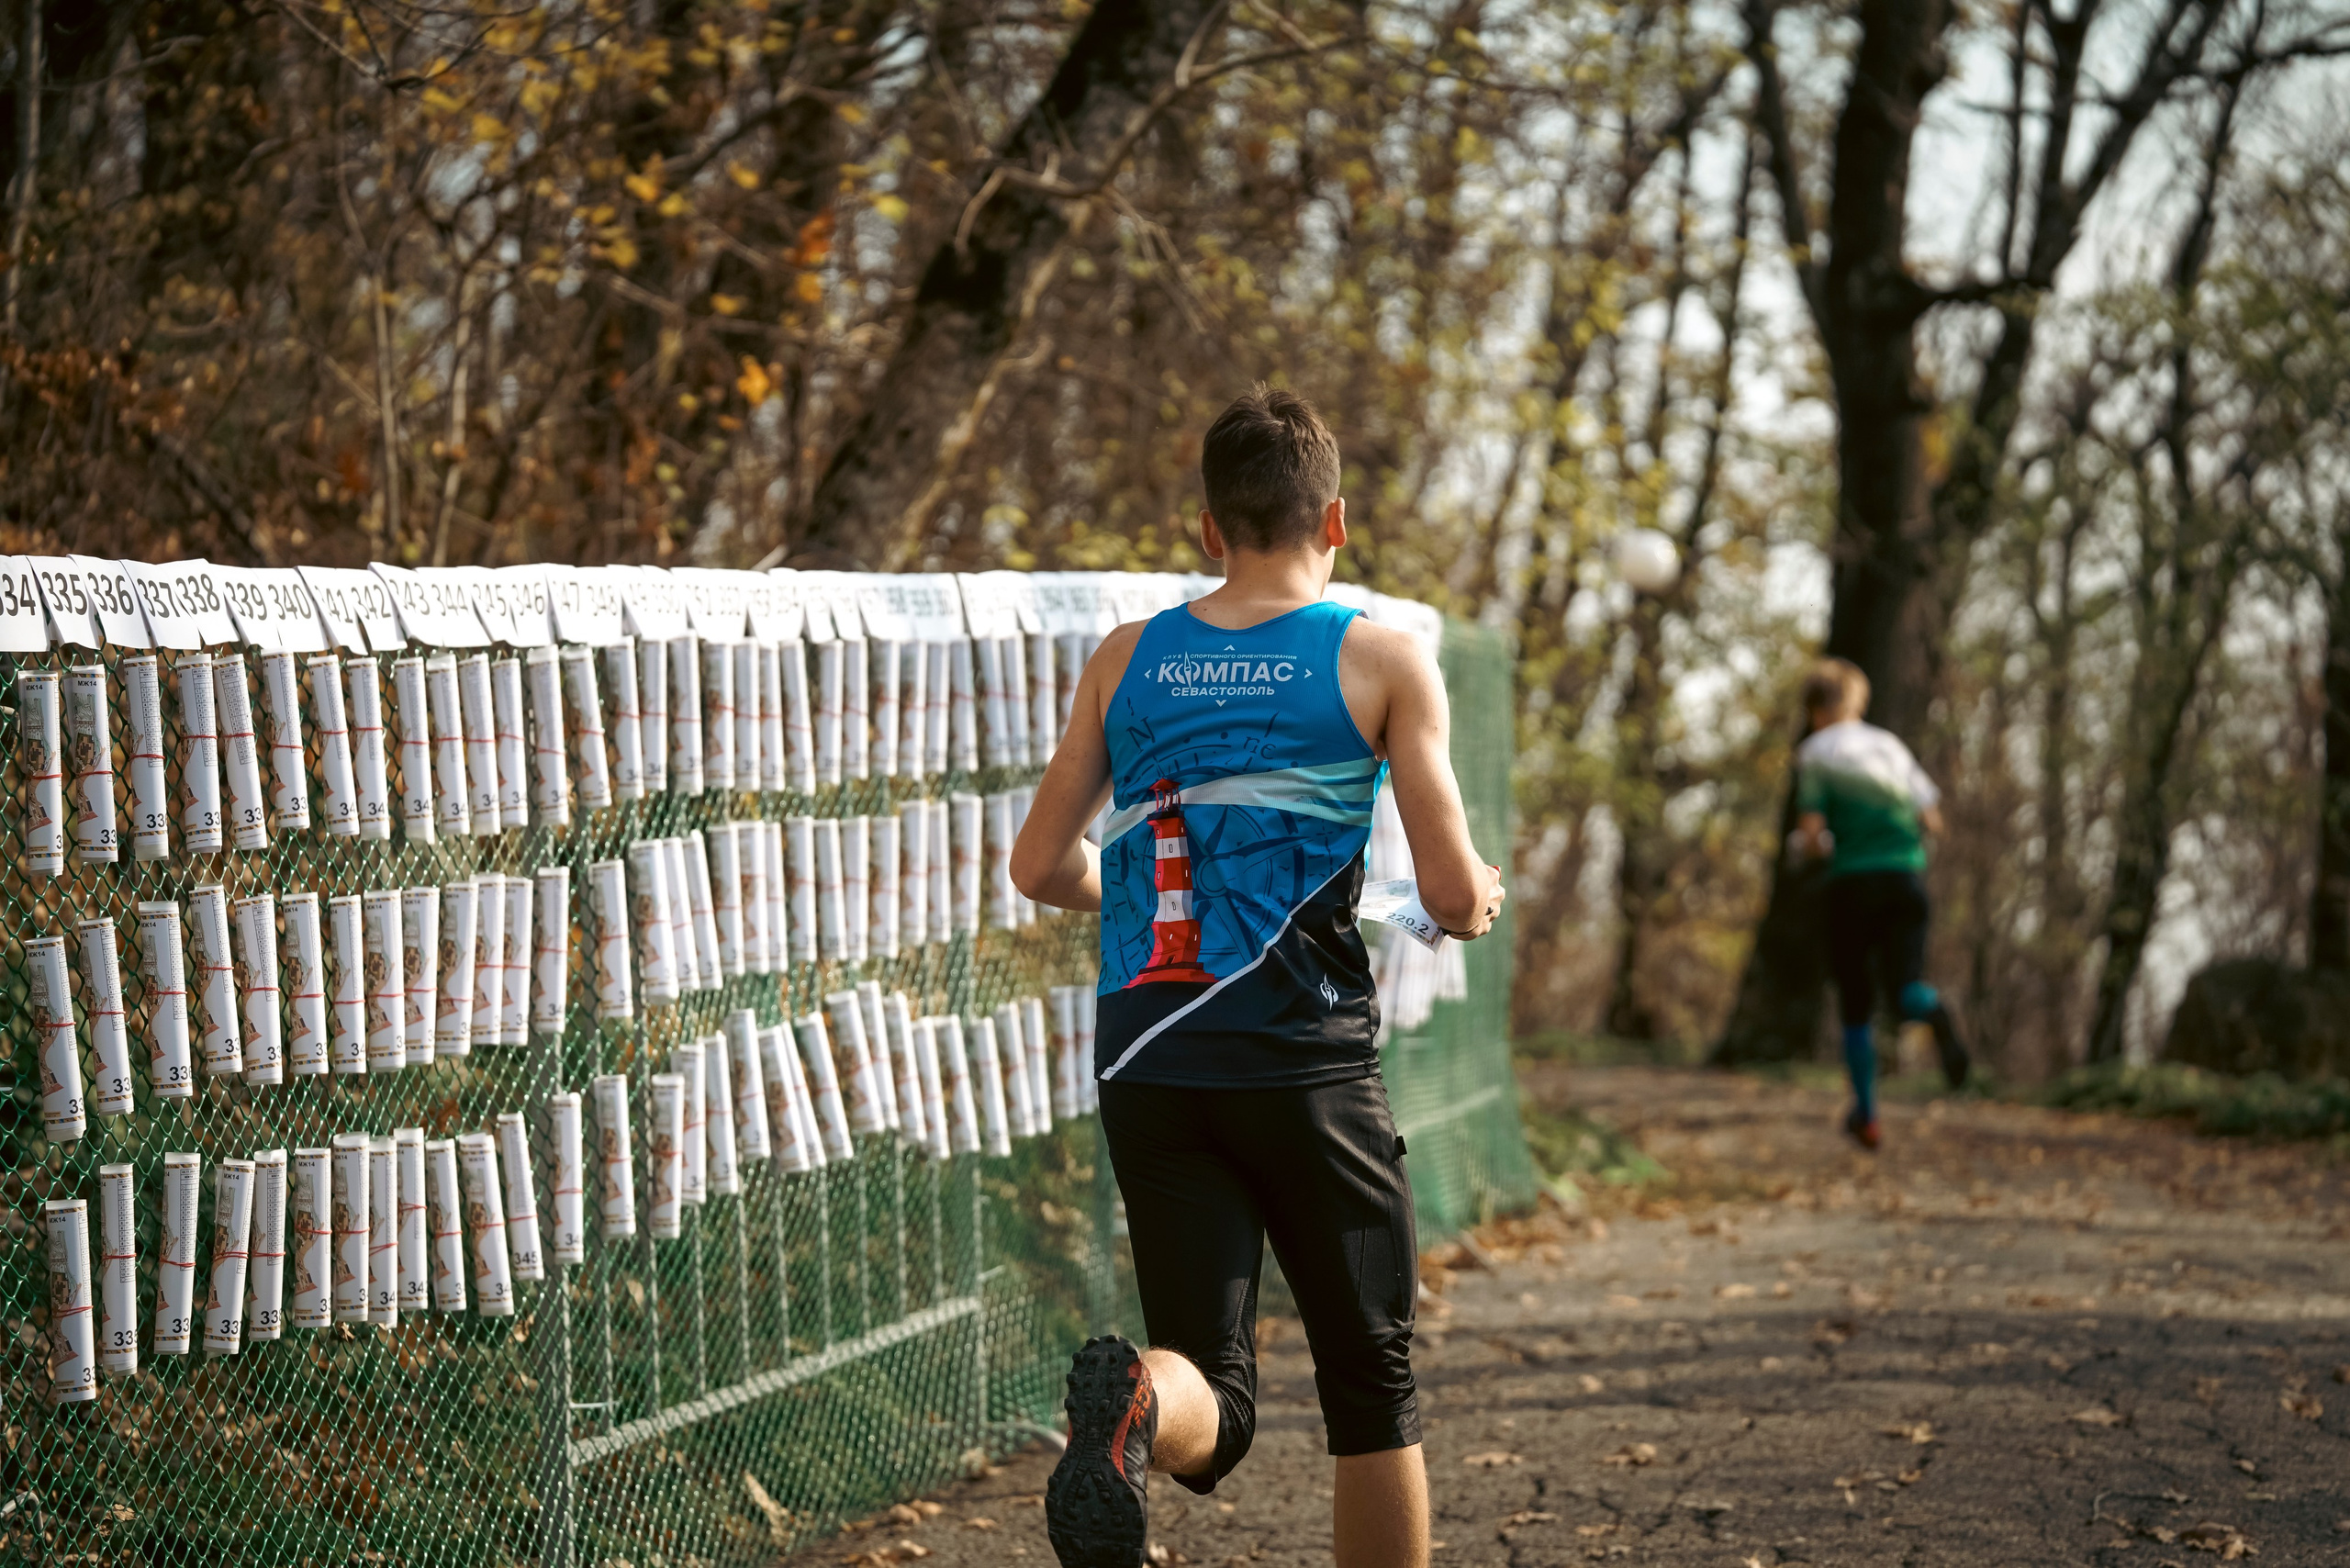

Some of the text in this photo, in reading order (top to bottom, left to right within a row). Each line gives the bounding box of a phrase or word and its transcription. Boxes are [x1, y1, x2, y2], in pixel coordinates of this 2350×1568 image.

[41, 571, 88, 616] 335
[87, 571, 135, 616] 336
[137, 577, 181, 619] 337
[176, 573, 221, 616] 338
[225, 581, 267, 621] 339
[268, 584, 311, 620] 340
[351, 584, 391, 620] 342
[431, 583, 469, 617] 344
[473, 583, 508, 617] 345
[512, 582, 546, 615] 346
[1157, 661, 1295, 685] КОМПАС
[1171, 686, 1275, 697] СЕВАСТОПОЛЬ
[1386, 912, 1429, 935] 220.2
[514, 1251, 538, 1264] 345
